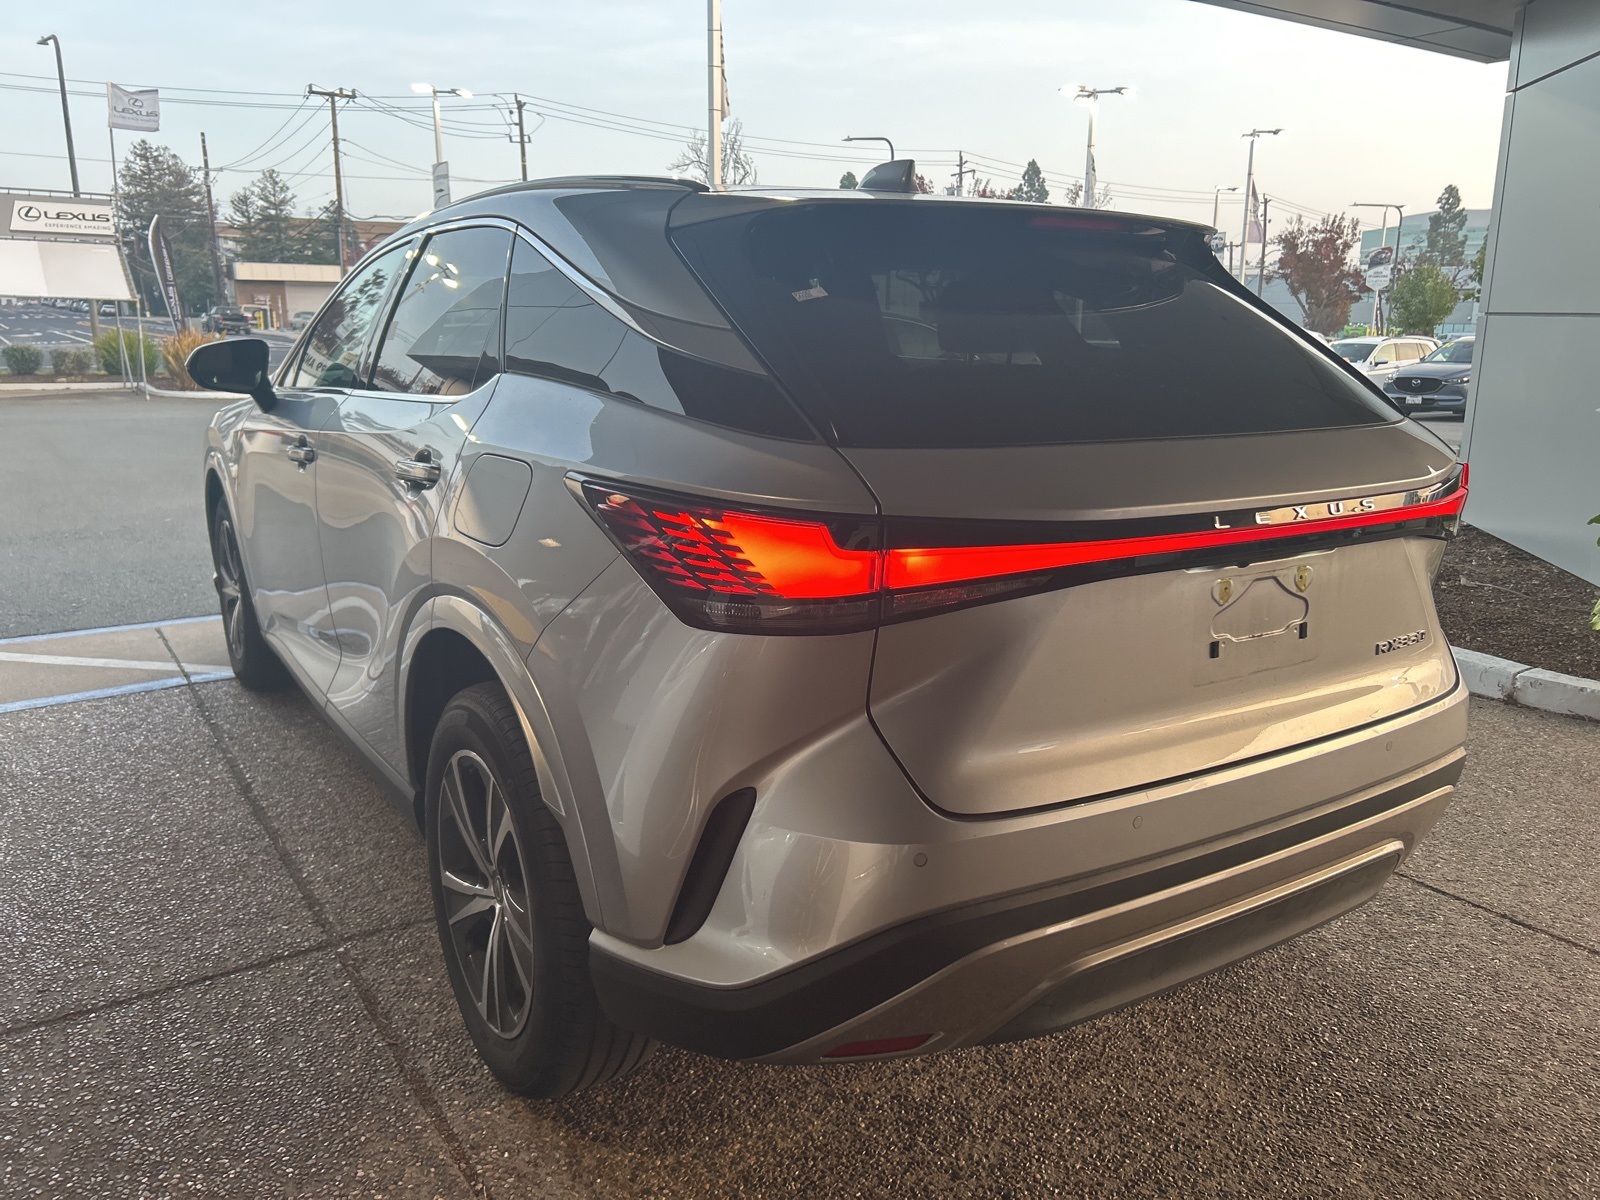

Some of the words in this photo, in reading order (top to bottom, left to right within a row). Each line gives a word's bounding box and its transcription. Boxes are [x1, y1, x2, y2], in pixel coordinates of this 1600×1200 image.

[113, 105, 158, 117] LEXUS
[43, 210, 110, 222] LEXUS
[83, 223, 111, 231] AMAZING
[1214, 498, 1376, 529] LEXUS
[1375, 629, 1426, 656] RX350
